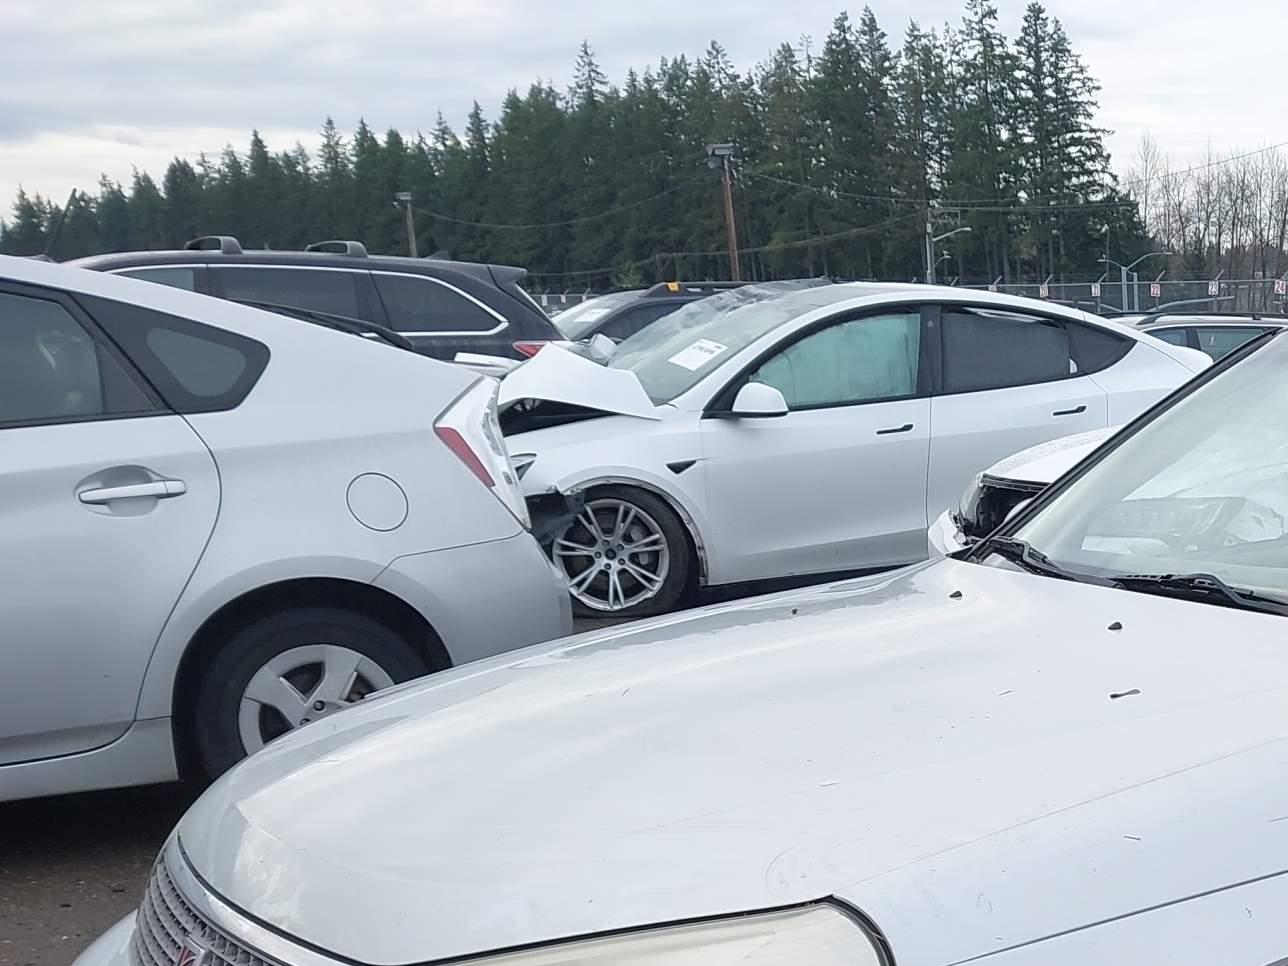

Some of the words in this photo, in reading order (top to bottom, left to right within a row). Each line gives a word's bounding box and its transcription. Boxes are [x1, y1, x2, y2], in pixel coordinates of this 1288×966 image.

[1151, 284, 1160, 296] 22
[1209, 281, 1218, 295] 23
[1275, 280, 1286, 294] 24
